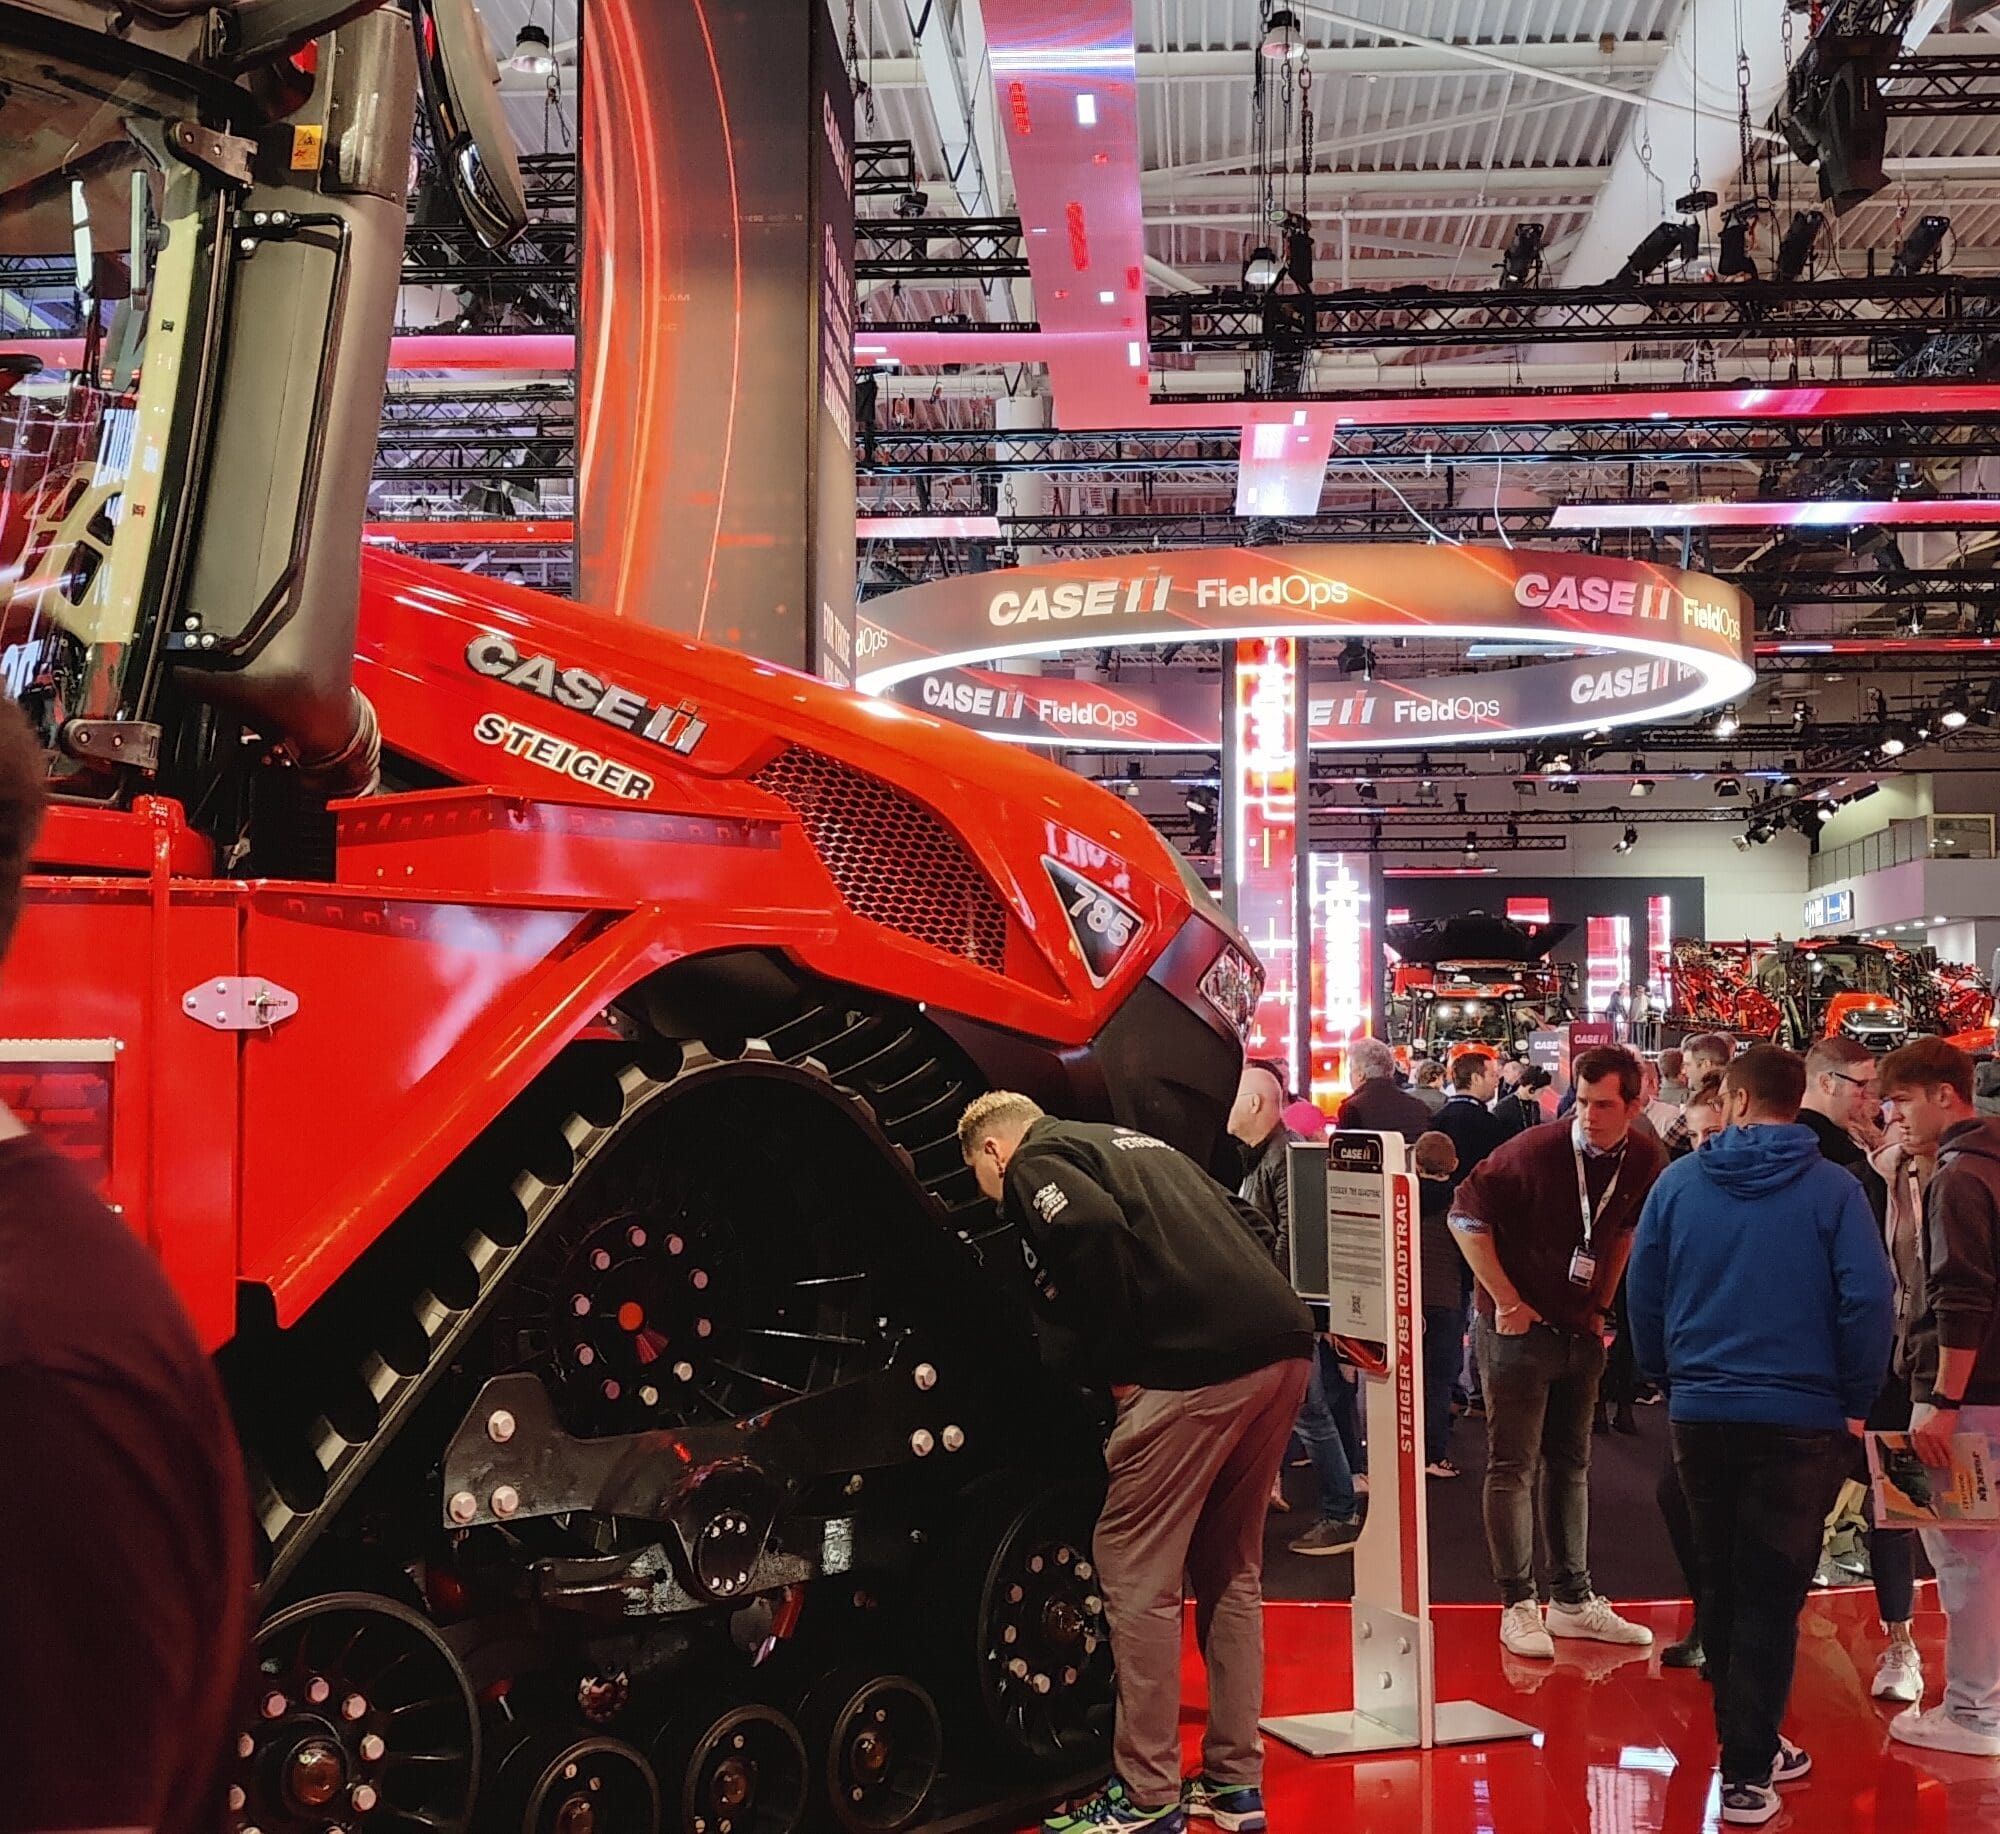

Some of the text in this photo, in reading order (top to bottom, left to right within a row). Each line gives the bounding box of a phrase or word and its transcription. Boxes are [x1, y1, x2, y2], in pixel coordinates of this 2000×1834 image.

[824, 91, 845, 182] CASE
[989, 580, 1119, 626] CASE
[1197, 575, 1349, 610] FieldOps
[1514, 574, 1638, 616] CASE
[1683, 598, 1740, 641] FieldOps
[856, 627, 888, 658] dOps
[465, 634, 649, 730] CASE
[923, 677, 993, 718] CASE
[1039, 699, 1138, 731] FieldOps
[1570, 662, 1650, 705] CASE
[1394, 696, 1500, 727] FieldOps
[474, 713, 655, 801] STEIGER
[1069, 882, 1133, 947] 785
[1575, 1035, 1598, 1044] CASE
[1341, 1148, 1363, 1160] CASE
[1396, 1194, 1412, 1453] STEIGER 785 QUADTRAC
